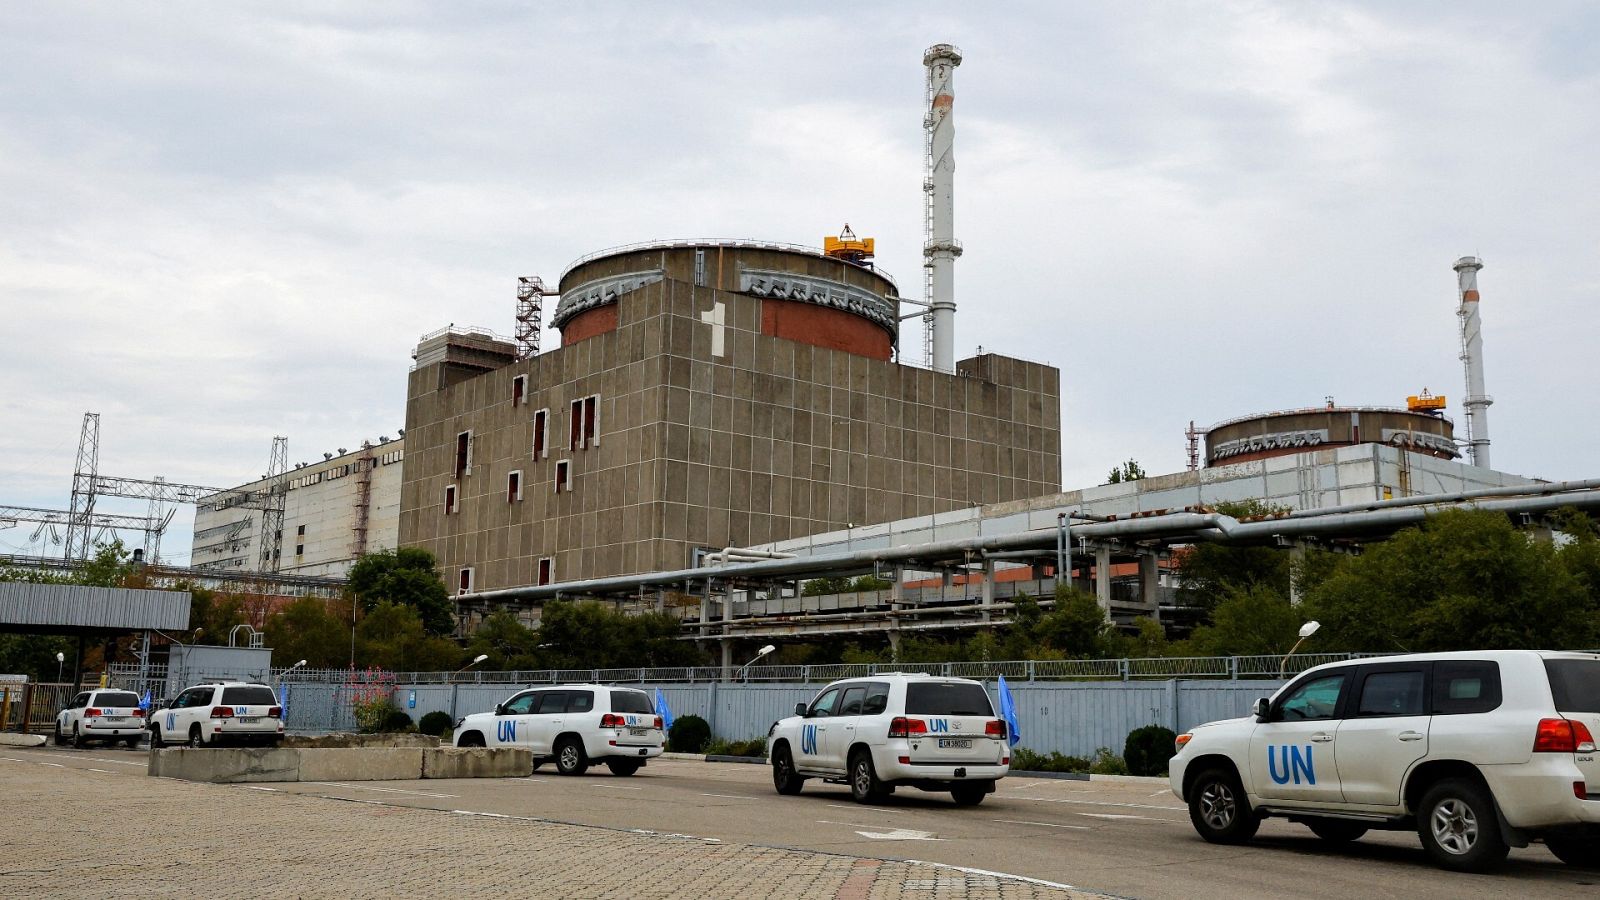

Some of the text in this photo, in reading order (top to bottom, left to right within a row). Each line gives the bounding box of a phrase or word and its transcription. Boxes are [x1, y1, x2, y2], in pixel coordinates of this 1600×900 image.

[701, 302, 725, 357] 1
[235, 707, 247, 715] UN
[626, 716, 637, 725] UN
[166, 713, 175, 731] UN
[498, 720, 516, 742] UN
[929, 719, 948, 732] UN
[802, 724, 817, 755] UN
[1268, 745, 1316, 785] UN
